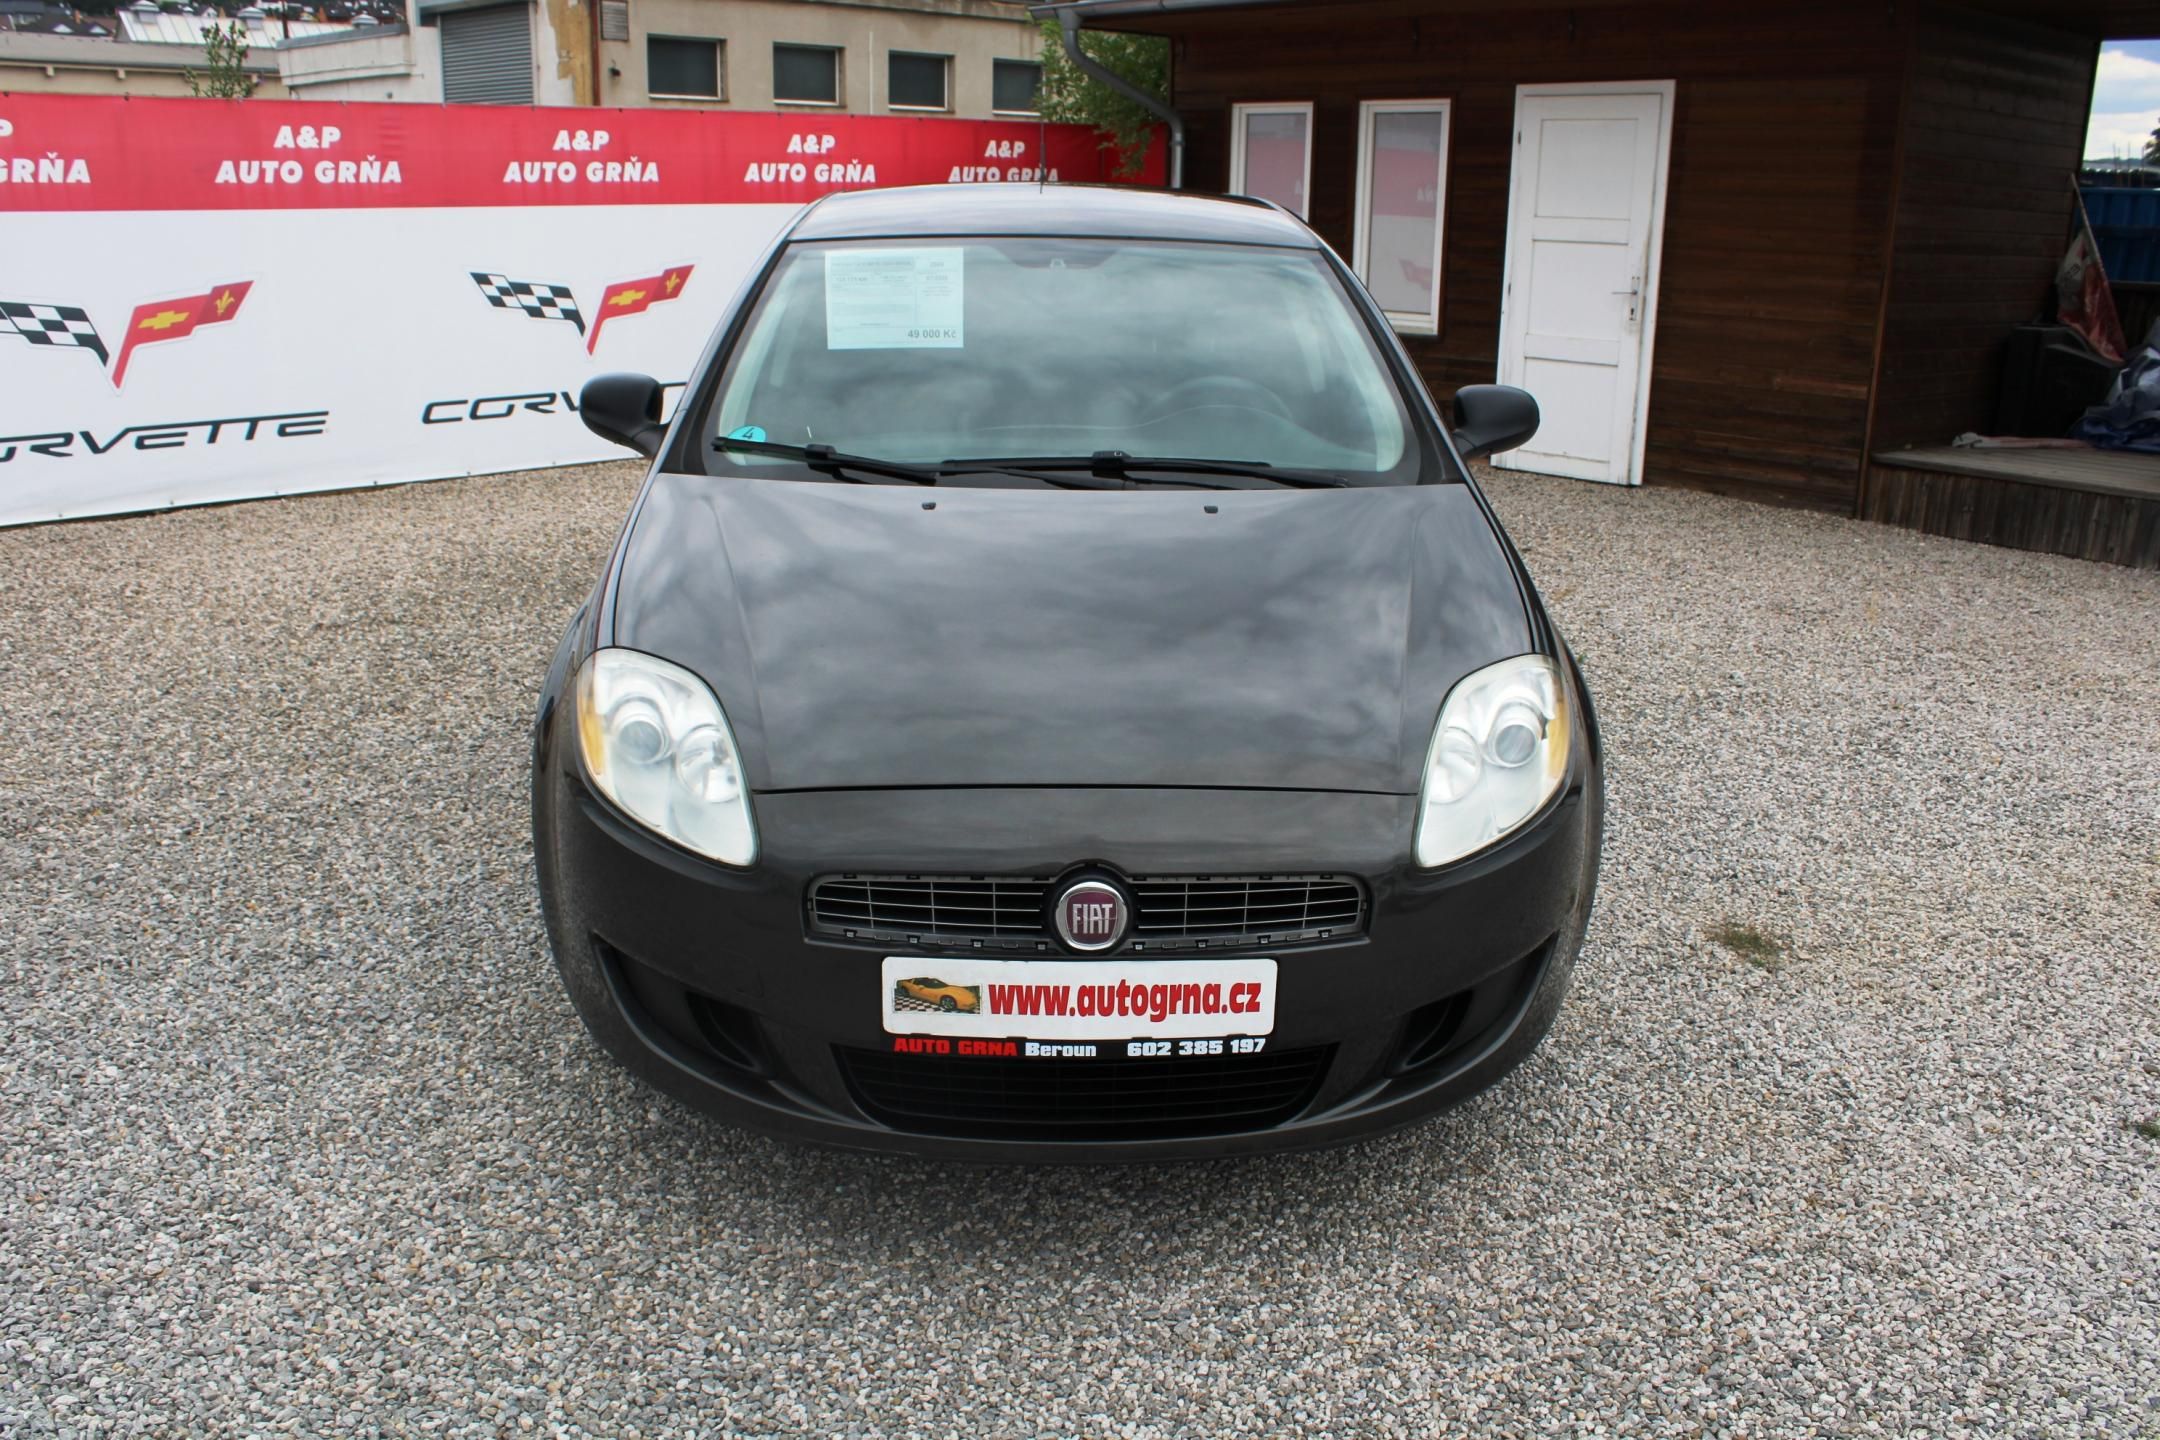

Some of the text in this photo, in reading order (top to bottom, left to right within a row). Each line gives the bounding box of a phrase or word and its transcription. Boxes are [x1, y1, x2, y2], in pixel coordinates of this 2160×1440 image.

[273, 125, 342, 149] A&P
[552, 129, 610, 152] A&P
[786, 134, 836, 154] A&P
[984, 140, 1025, 158] A&P
[214, 154, 402, 184] AUTO GRŇA
[503, 156, 659, 183] AUTO GRŇA
[743, 159, 876, 183] AUTO GRŇA
[947, 166, 1001, 182] AUTO
[907, 328, 958, 339] 49 000 Kč
[1071, 903, 1114, 935] FIAT
[988, 979, 1262, 1023] www.autogrna.cz
[894, 1037, 1267, 1057] AUTO GRNA Beroun 602 385 197
